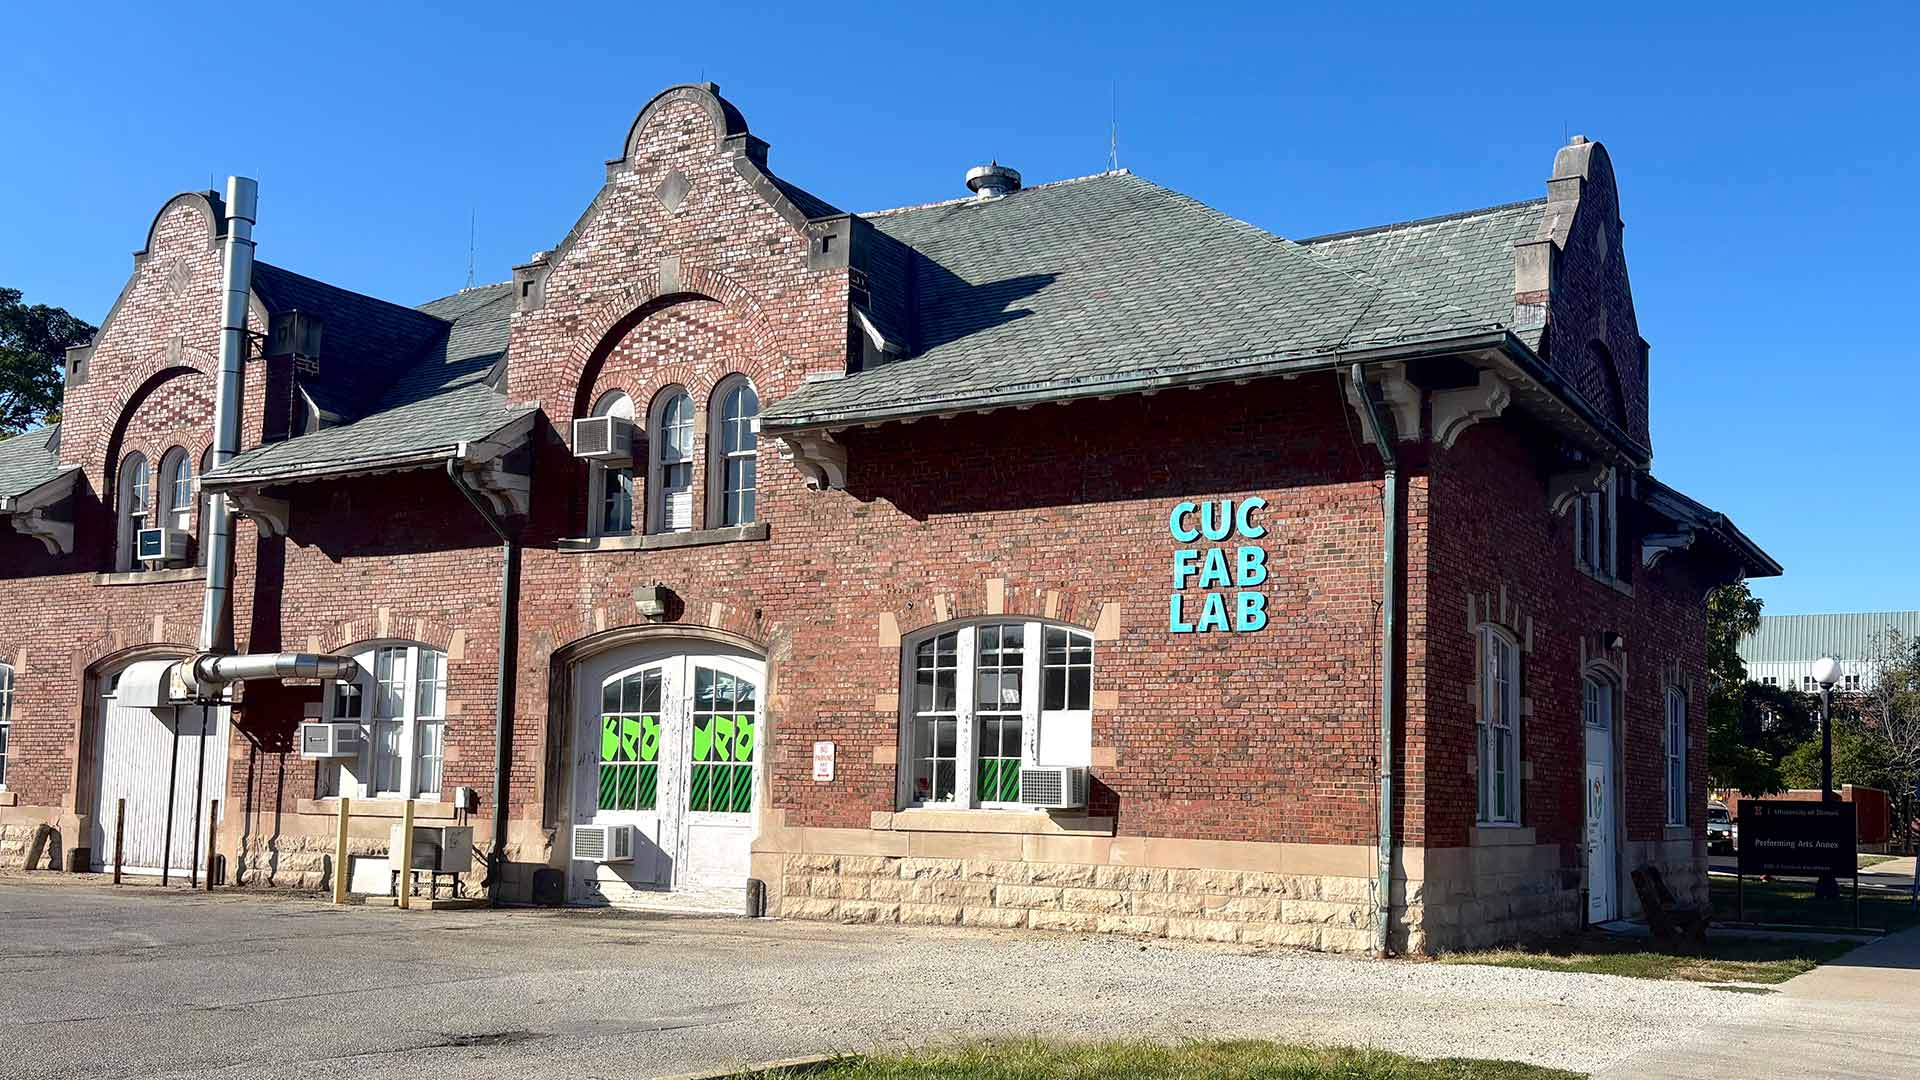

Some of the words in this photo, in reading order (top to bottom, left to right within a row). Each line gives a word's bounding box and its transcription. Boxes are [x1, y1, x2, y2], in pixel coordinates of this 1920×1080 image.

[1169, 496, 1268, 542] CUC
[1173, 546, 1268, 589] FAB
[1169, 591, 1268, 633] LAB
[1755, 839, 1795, 849] Performing
[1798, 840, 1813, 848] Arts
[1815, 840, 1839, 849] Annex
